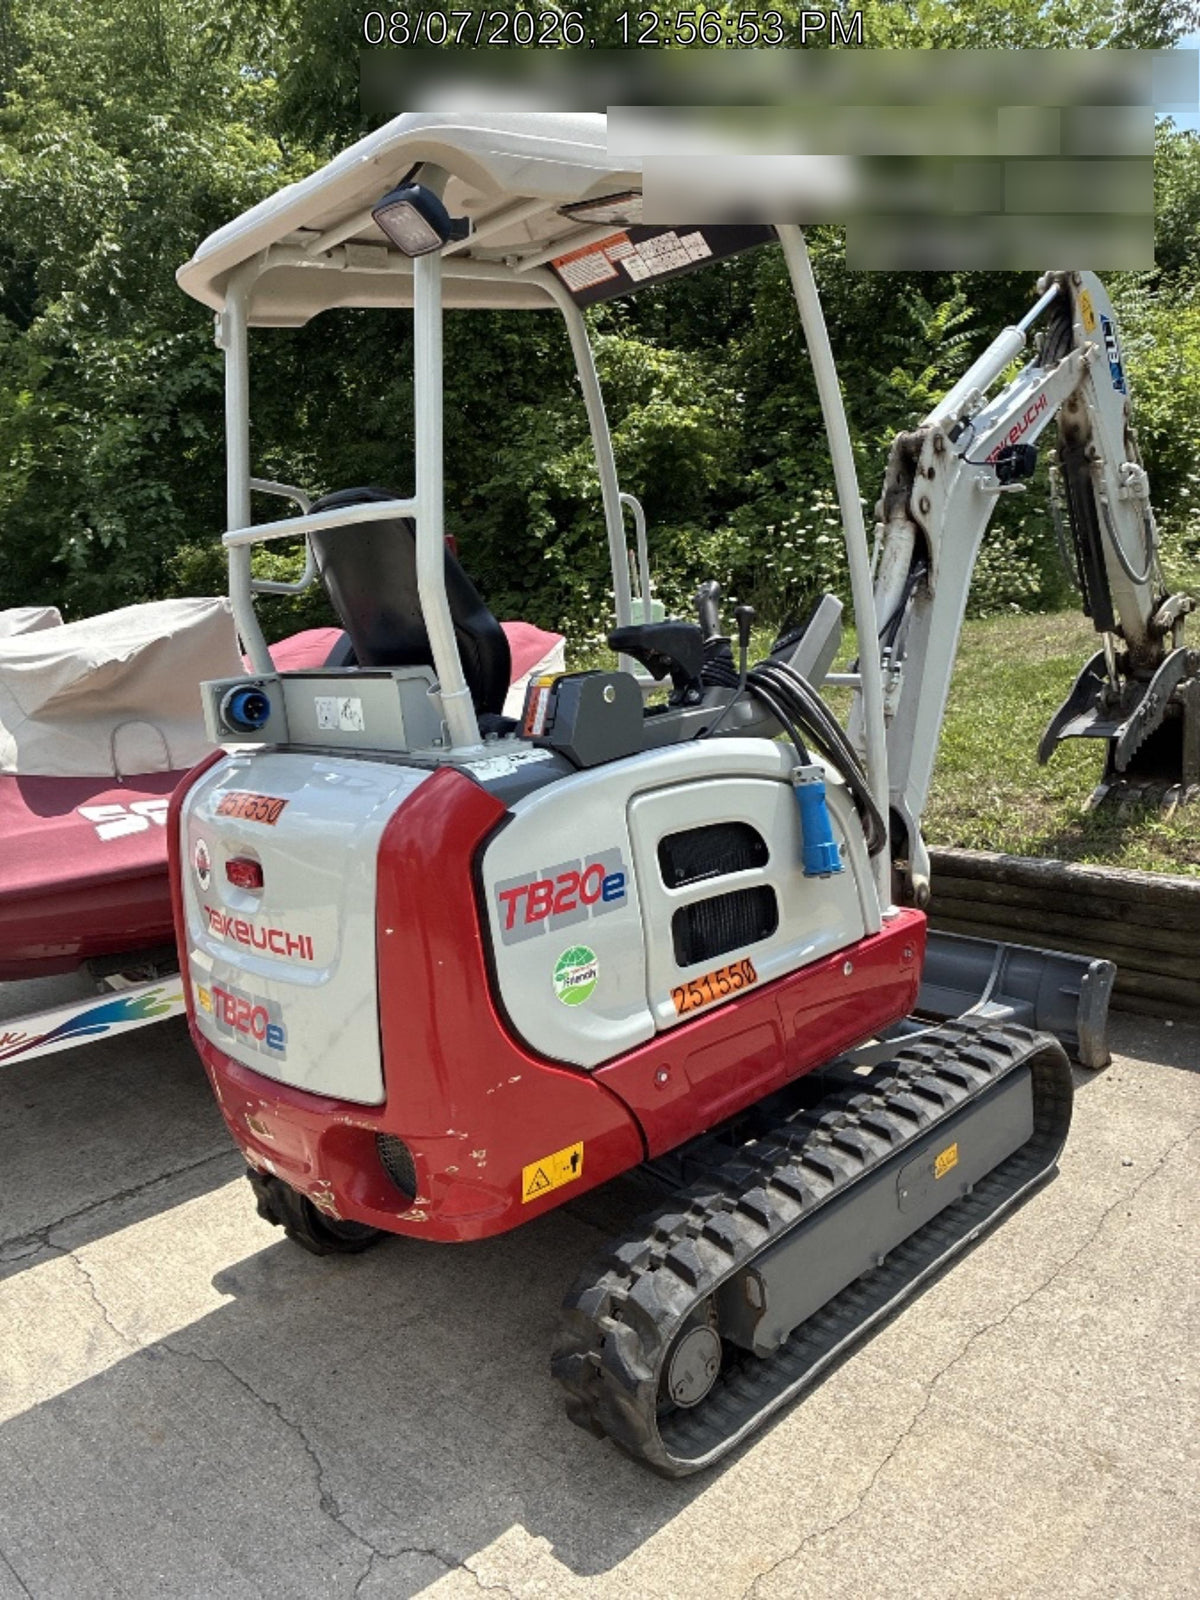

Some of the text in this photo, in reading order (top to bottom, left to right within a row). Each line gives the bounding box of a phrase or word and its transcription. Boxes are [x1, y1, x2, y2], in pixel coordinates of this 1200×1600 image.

[499, 863, 625, 930] TB20e
[211, 985, 286, 1051] TB20e
[673, 958, 757, 1013] 251550
